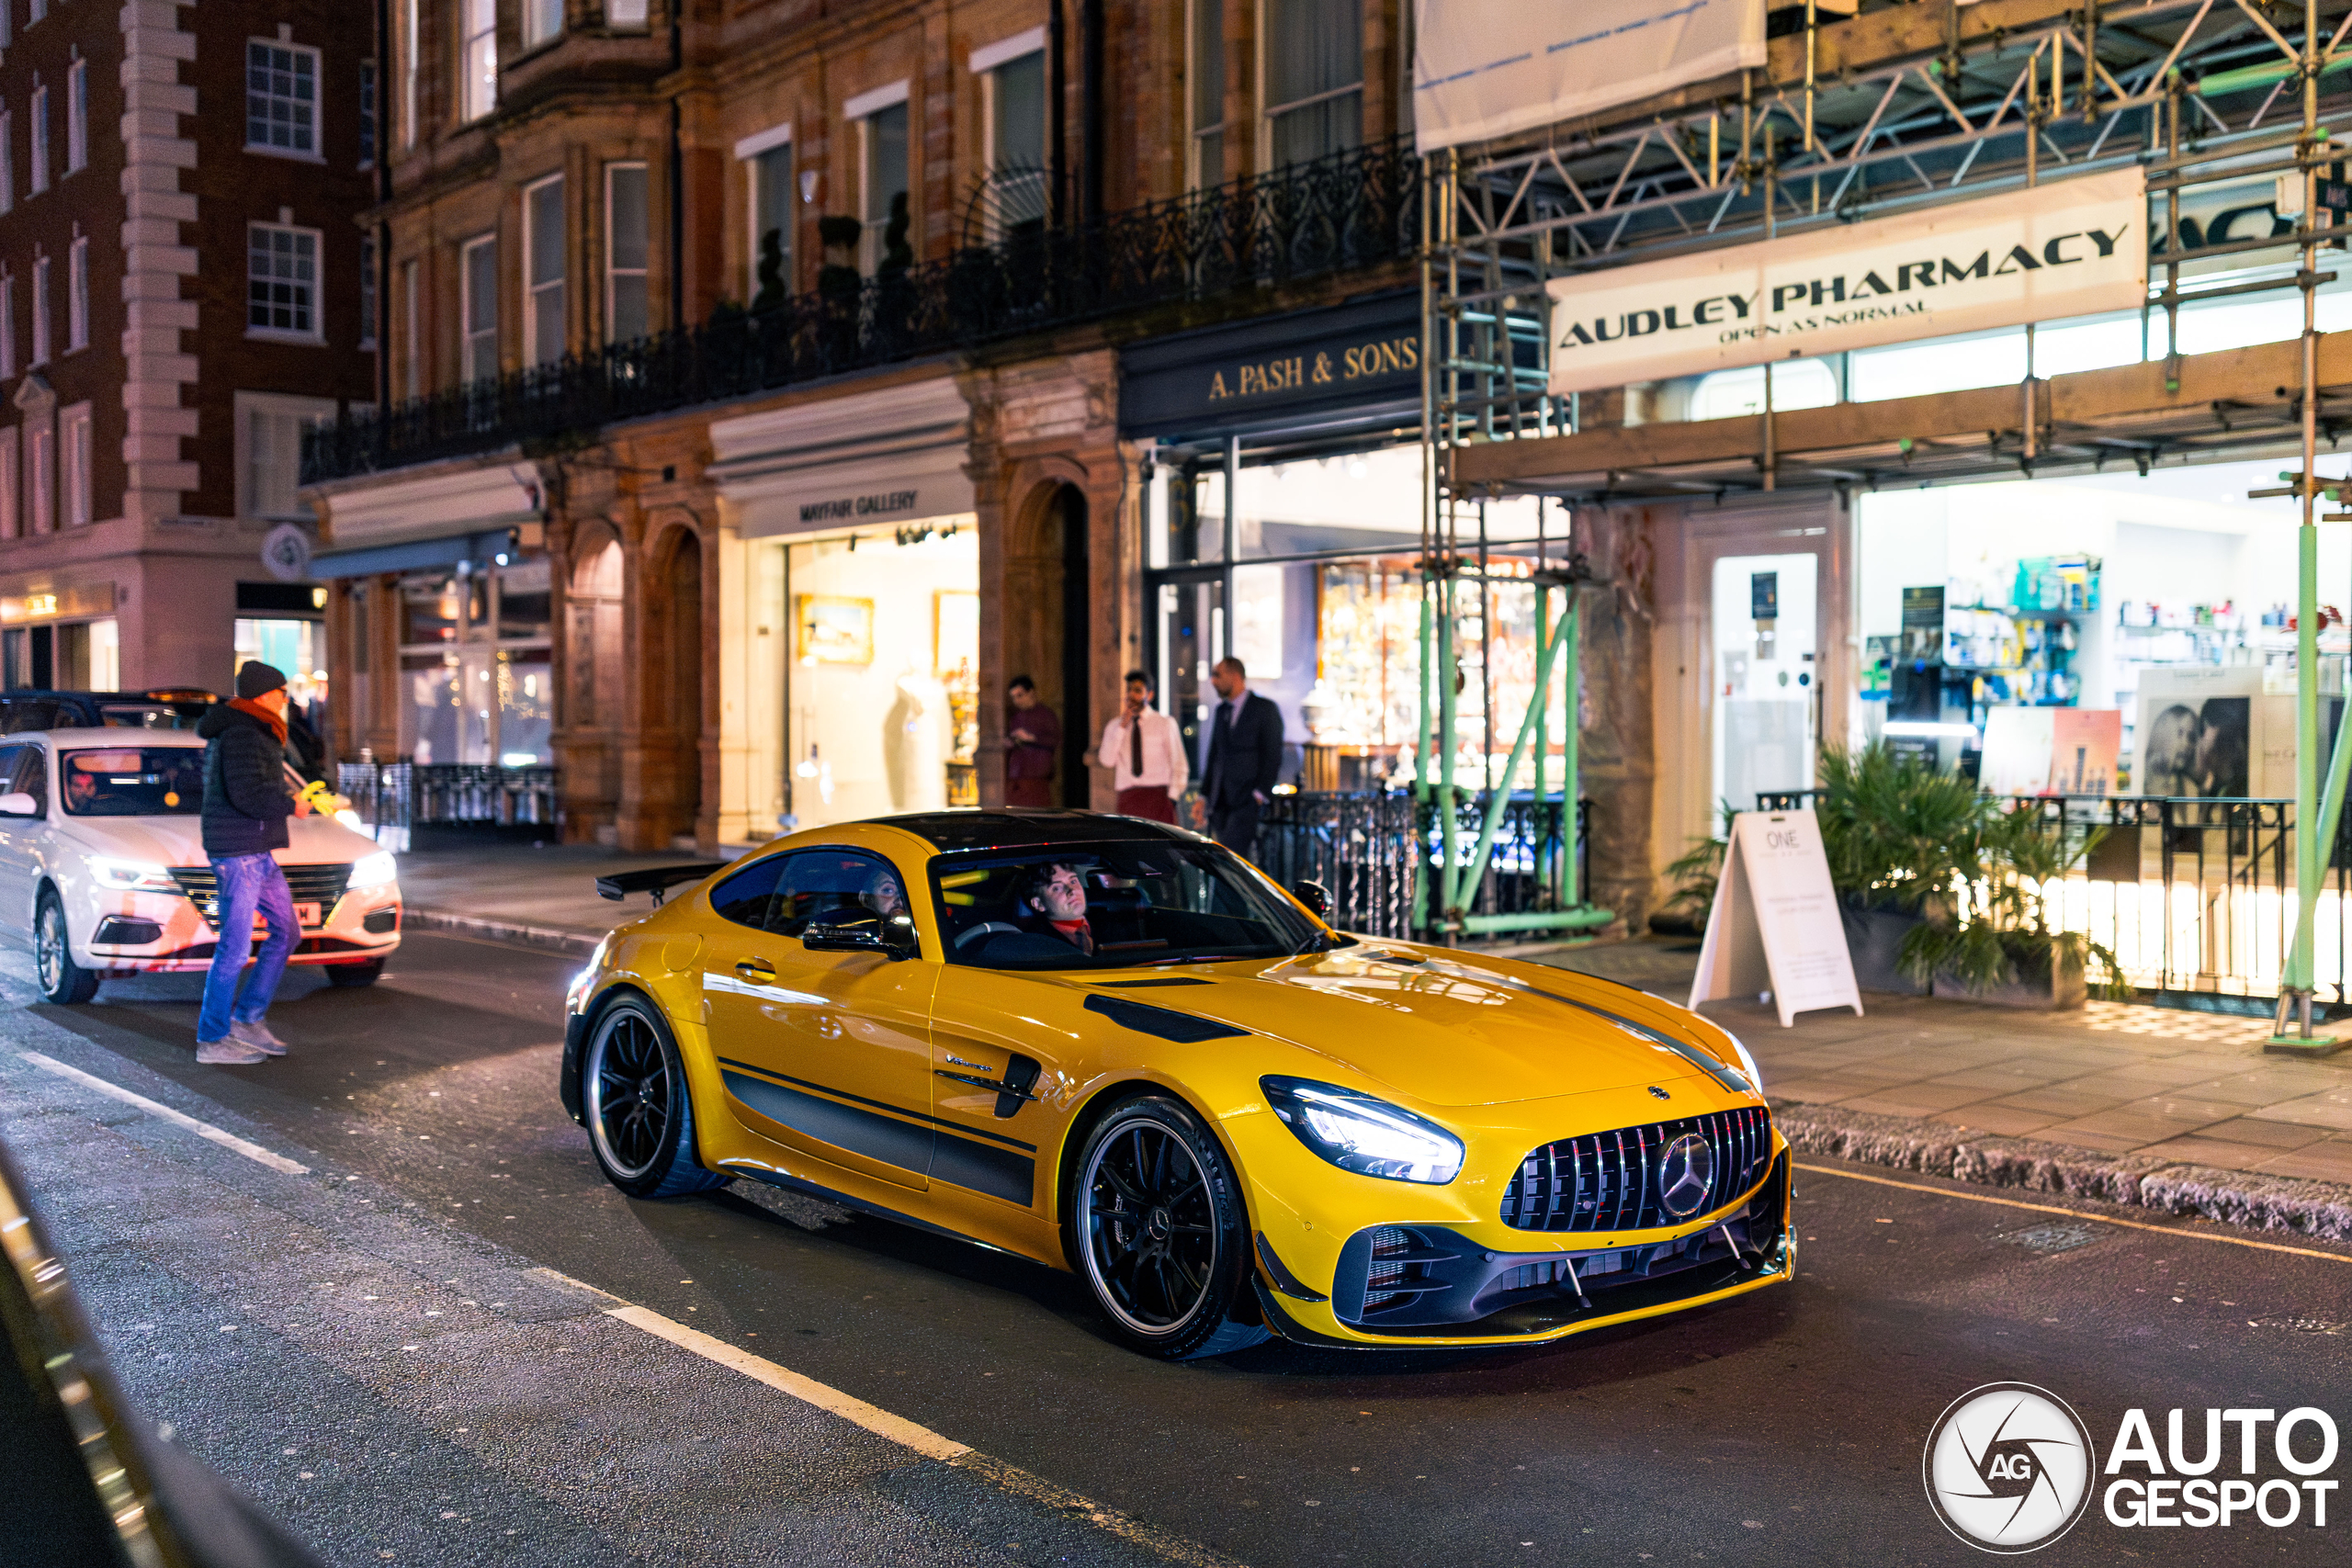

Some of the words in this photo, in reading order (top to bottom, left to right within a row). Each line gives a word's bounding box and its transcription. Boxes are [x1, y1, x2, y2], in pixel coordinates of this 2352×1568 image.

[1557, 288, 1760, 349] AUDLEY
[1772, 222, 2129, 313] PHARMACY
[1719, 321, 1781, 344] OPEN
[1787, 316, 1817, 335] AS
[1824, 300, 1933, 325] NORMAL
[1208, 370, 1235, 400] A.
[1239, 355, 1303, 396] PASH
[1312, 351, 1332, 384] &
[1344, 336, 1419, 380] SONS
[799, 498, 853, 523] MAYFAIR
[856, 490, 918, 516] GALLERY
[1766, 829, 1801, 850] ONE
